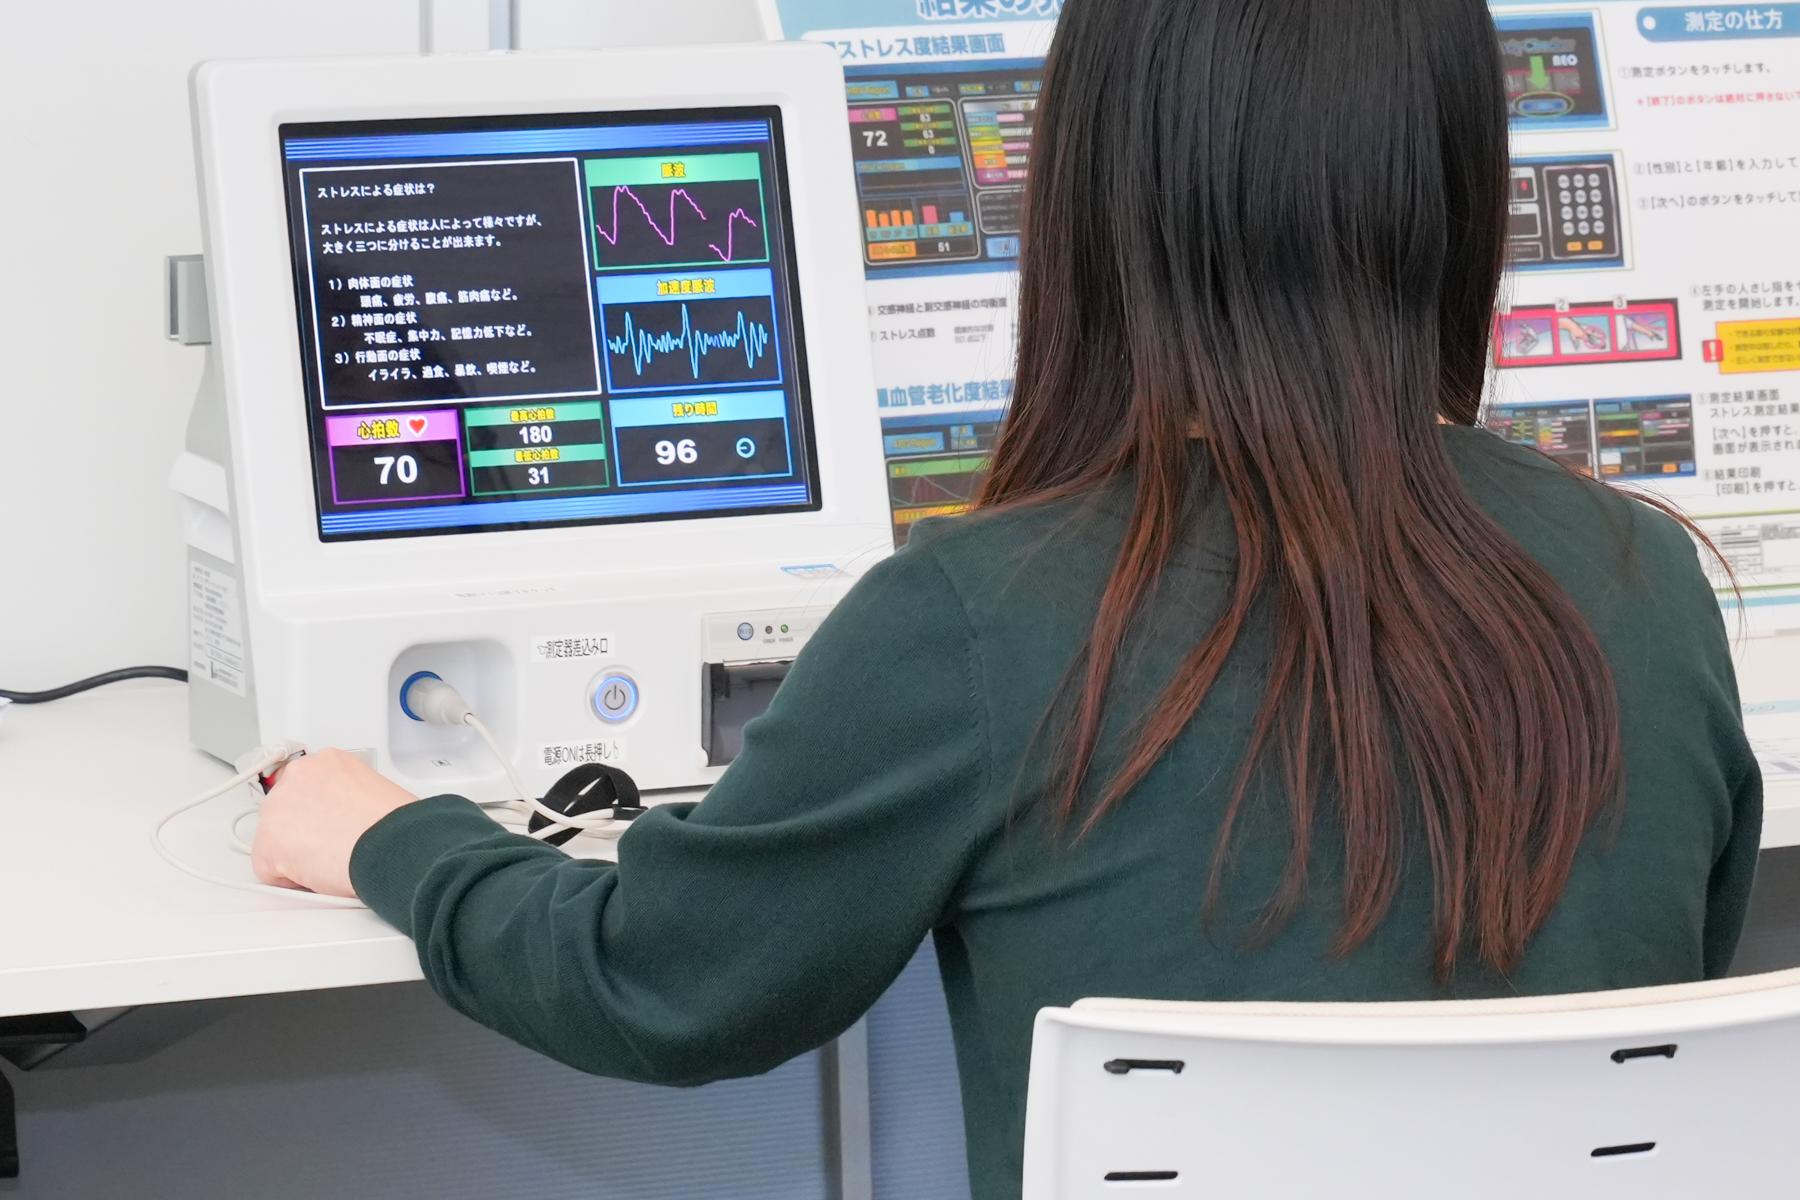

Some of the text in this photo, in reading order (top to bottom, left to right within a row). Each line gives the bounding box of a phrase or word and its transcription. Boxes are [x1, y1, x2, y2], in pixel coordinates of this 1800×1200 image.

[1684, 9, 1783, 32] 測定の仕方
[840, 33, 1006, 58] ストレス度結果画面
[862, 130, 888, 147] 72
[318, 183, 435, 199] ストレスによる症状は？
[323, 235, 502, 254] 大きく三つに分けることが出来ます。
[1557, 298, 1566, 311] 2
[673, 402, 718, 417] 残り時間
[357, 419, 401, 440] 心拍数
[519, 426, 553, 444] 180
[655, 438, 698, 465] 96
[374, 454, 418, 485] 70
[528, 466, 550, 485] 31
